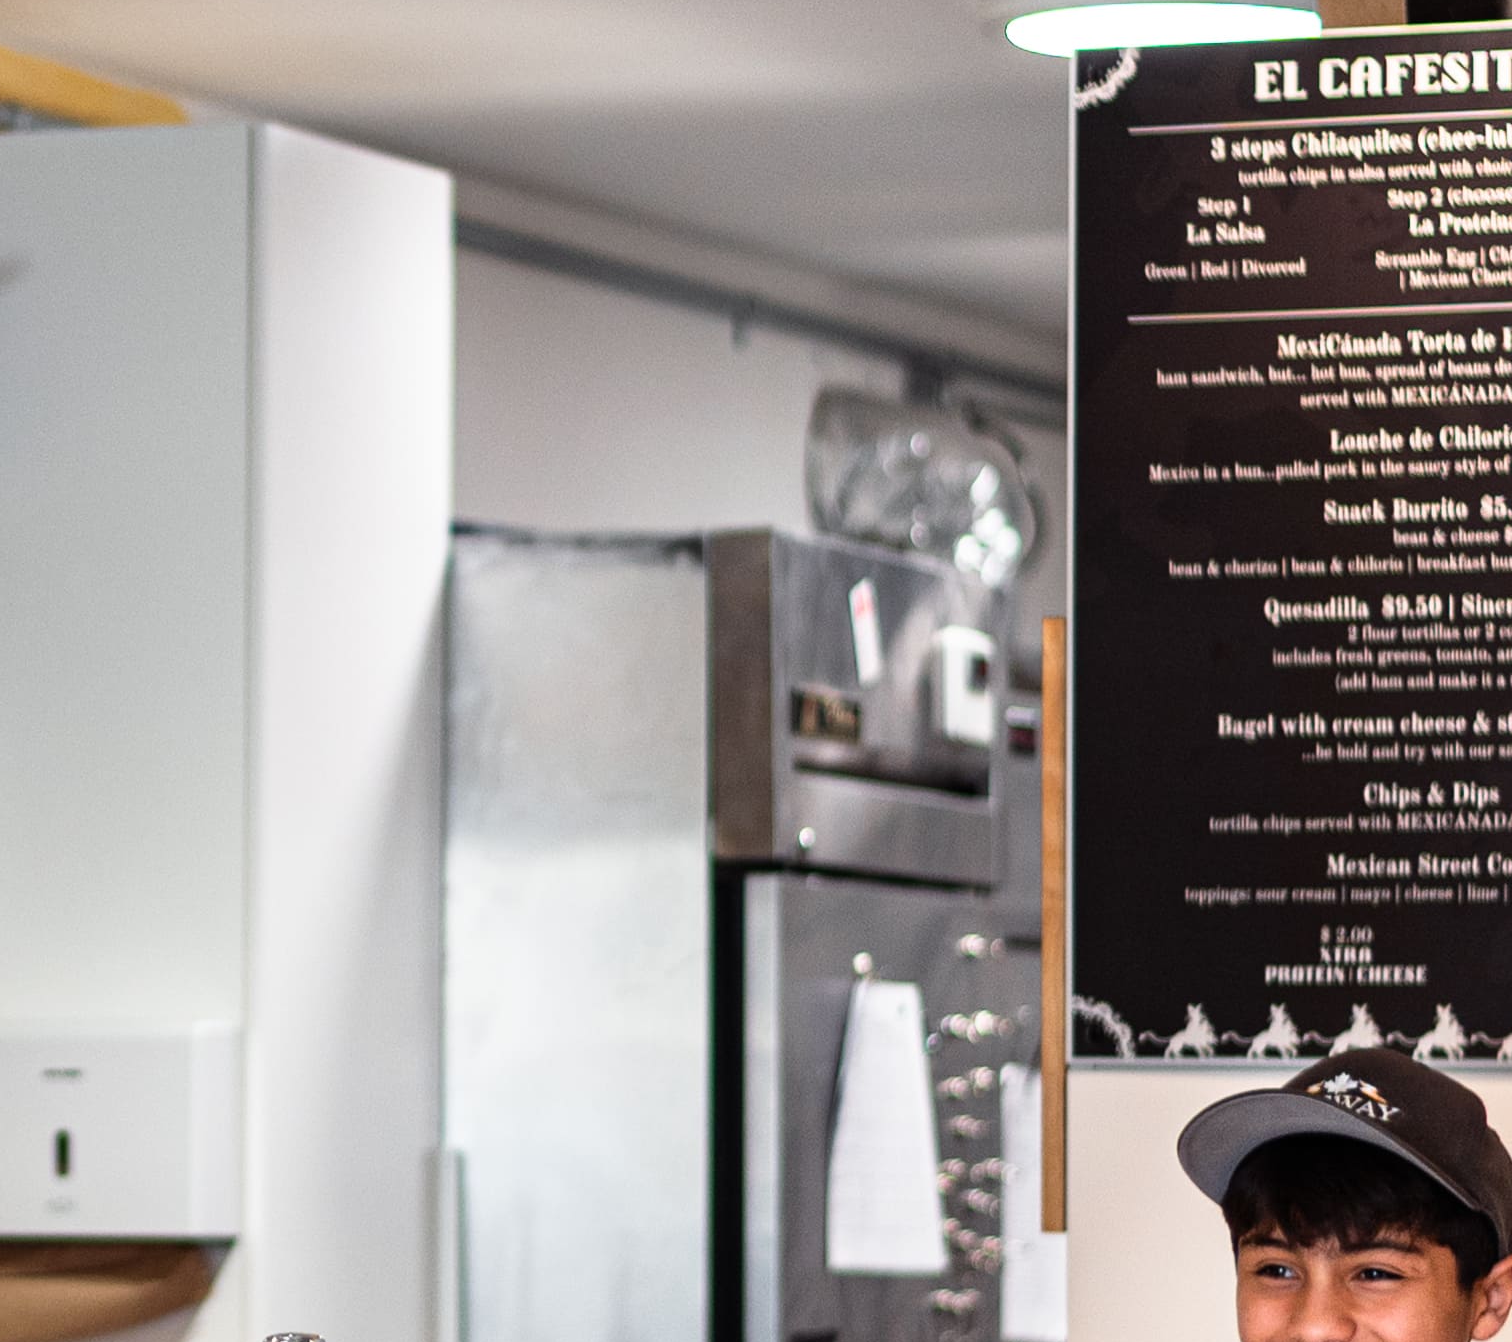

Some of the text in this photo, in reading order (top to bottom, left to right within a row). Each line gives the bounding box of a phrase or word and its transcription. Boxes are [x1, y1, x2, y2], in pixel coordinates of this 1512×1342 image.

[1255, 60, 1306, 101] EL
[1211, 137, 1225, 160] 3
[1232, 139, 1286, 163] steps
[1292, 129, 1413, 159] Chilaquiles
[1407, 330, 1466, 354] Torta
[1471, 328, 1496, 352] de
[1410, 427, 1433, 451] de
[1264, 597, 1369, 625] Quesadilla
[1382, 595, 1442, 618] $9.50
[1219, 714, 1274, 739] Bagel
[1282, 714, 1325, 734] with
[1333, 718, 1393, 734] cream
[1401, 712, 1466, 734] cheese
[1473, 711, 1489, 734] &
[1364, 783, 1420, 808] Chips
[1428, 783, 1443, 805] &
[1454, 782, 1499, 808] Dips
[1326, 1094, 1401, 1122] WAY
